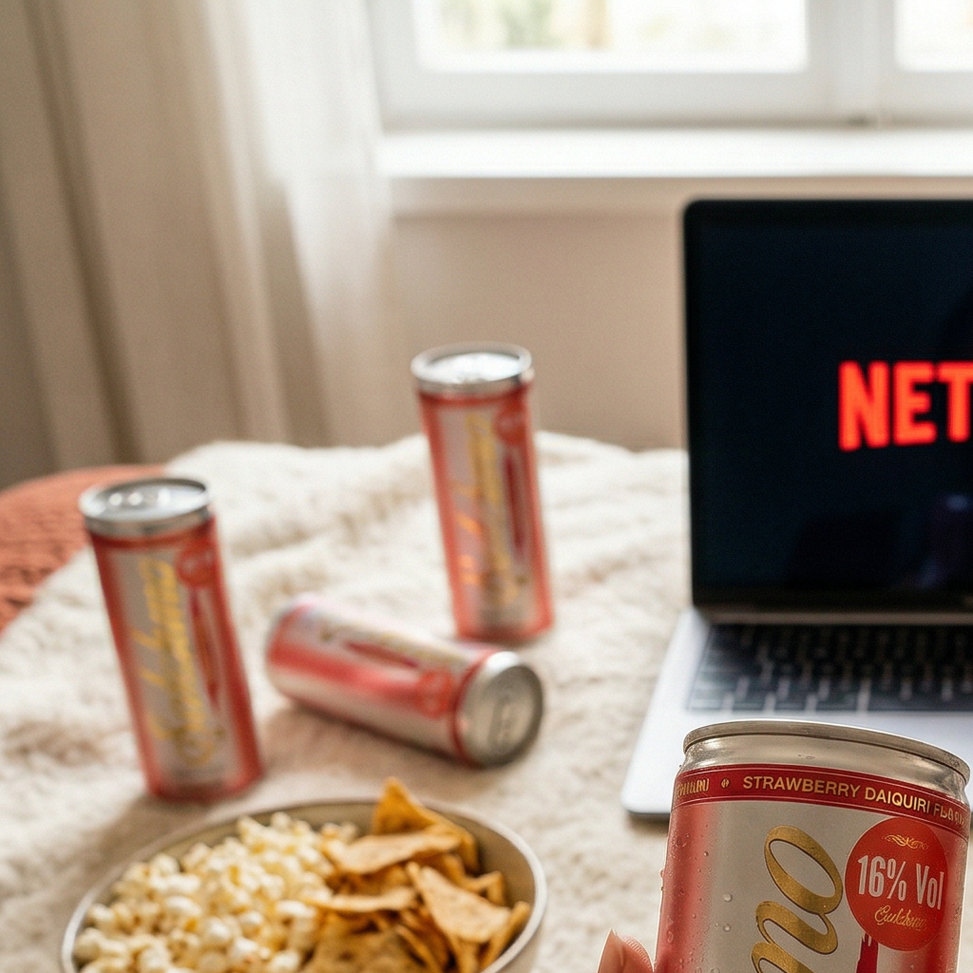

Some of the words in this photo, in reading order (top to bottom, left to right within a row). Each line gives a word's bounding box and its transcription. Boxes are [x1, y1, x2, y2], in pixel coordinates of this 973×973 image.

[743, 776, 860, 798] STRAWBERRY
[864, 787, 930, 814] DAIQUIRI
[857, 855, 907, 901] 16%
[916, 863, 945, 911] Vol
